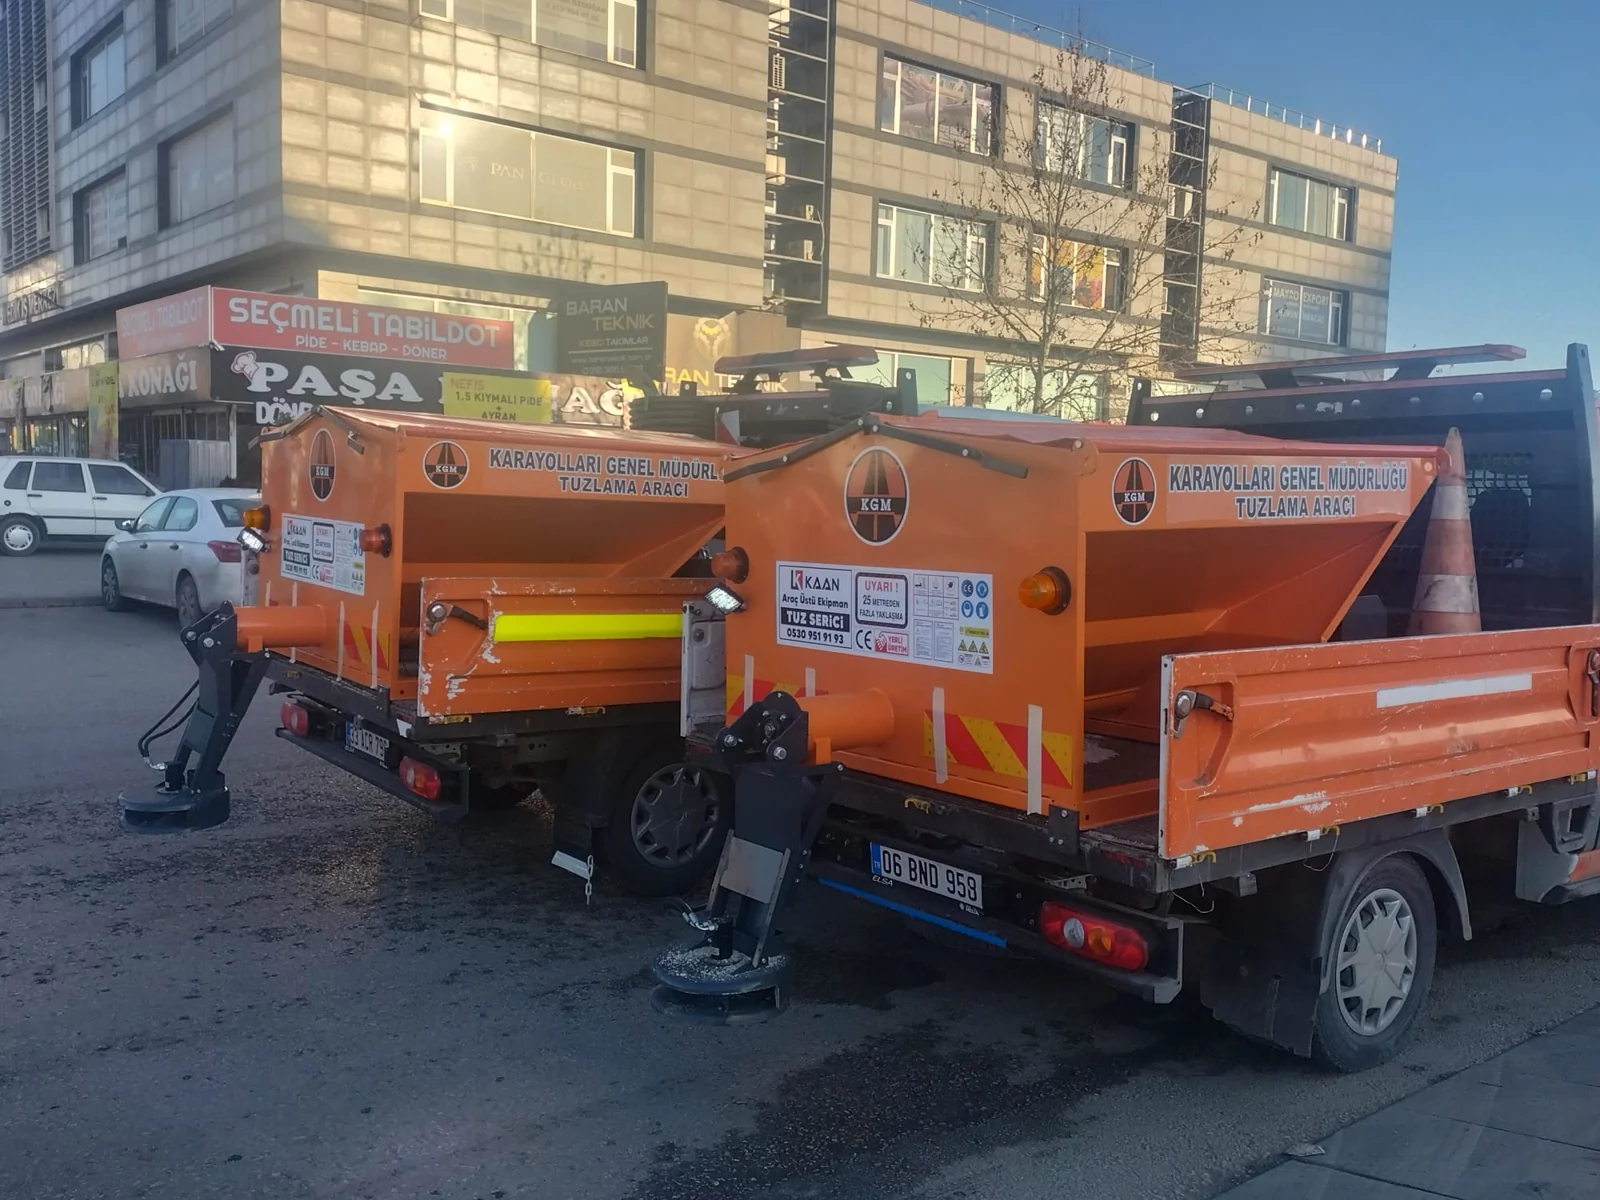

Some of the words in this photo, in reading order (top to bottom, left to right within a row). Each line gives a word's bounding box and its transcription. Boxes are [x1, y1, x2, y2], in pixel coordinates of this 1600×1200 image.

[566, 297, 628, 316] BARAN
[343, 339, 388, 354] KEBAP
[403, 344, 447, 360] DÖNER
[247, 362, 423, 405] PAŞA
[474, 393, 517, 405] KIYMALI
[481, 411, 516, 422] AYRAN
[315, 465, 331, 477] KGM
[434, 464, 458, 474] KGM
[488, 447, 601, 474] KARAYOLLARI
[606, 456, 655, 478] GENEL
[658, 455, 724, 481] MÜDÜRL
[1168, 464, 1275, 493] KARAYOLLARI
[1279, 464, 1324, 492] GENEL
[1328, 461, 1408, 492] MÜDÜRLÜĞÜ
[559, 476, 637, 496] TUZLAMA
[641, 480, 690, 498] ARACI
[861, 498, 891, 511] KGM
[1123, 492, 1146, 503] KGM
[1235, 495, 1309, 519] TUZLAMA
[1312, 495, 1357, 518] ARACI
[805, 576, 840, 592] KAAN
[864, 581, 893, 593] UYARI
[782, 593, 798, 607] Araç
[800, 592, 816, 605] Üstü
[818, 597, 849, 610] Ekipman
[862, 595, 872, 606] 25
[872, 599, 900, 608] METREDEN
[786, 610, 807, 624] TUZ
[859, 609, 875, 618] FAZLA
[786, 628, 806, 640] 0530
[808, 630, 823, 642] 951
[823, 632, 832, 643] 91
[834, 633, 844, 645] 93
[855, 629, 872, 650] CE
[872, 875, 893, 887] ELSA
[882, 850, 902, 877] 06
[908, 857, 939, 889] BND
[946, 869, 978, 902] 958
